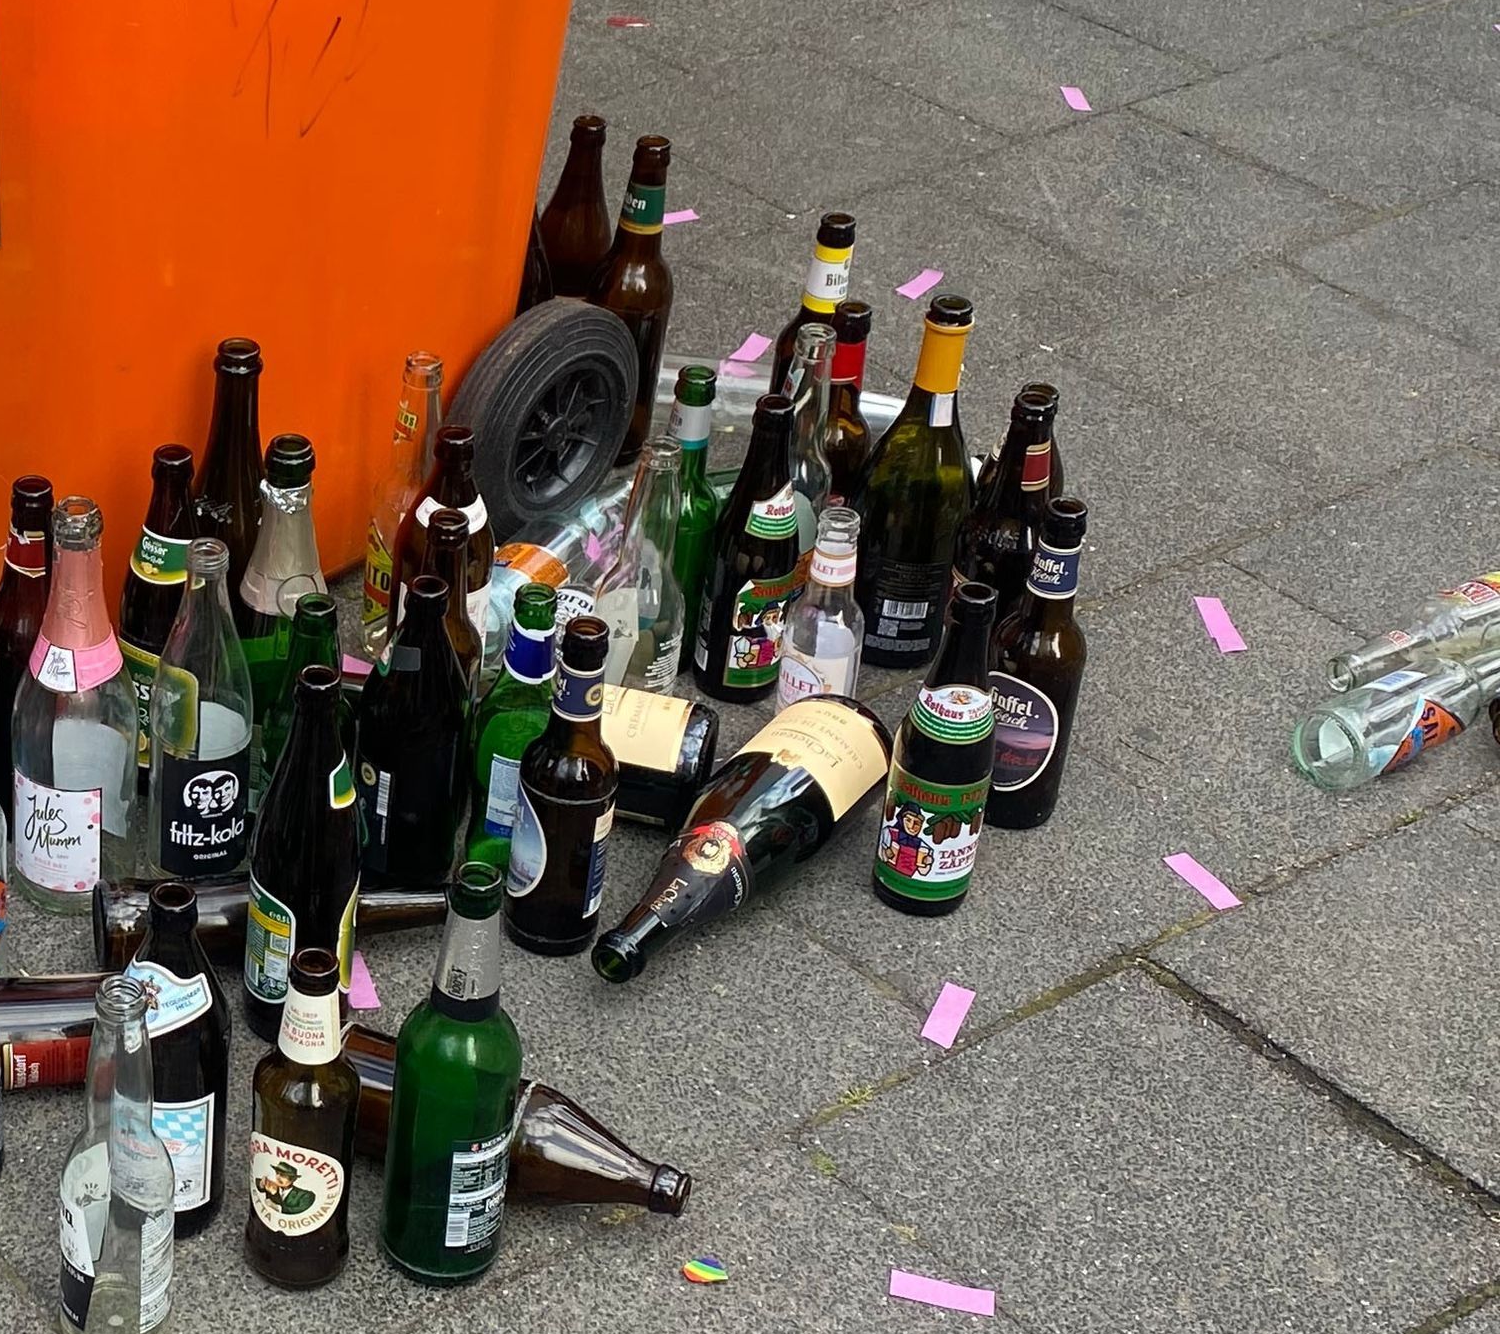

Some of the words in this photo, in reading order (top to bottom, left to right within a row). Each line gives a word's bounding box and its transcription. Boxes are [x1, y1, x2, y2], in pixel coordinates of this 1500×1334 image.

[23, 795, 68, 841] Jules
[169, 817, 245, 847] fritz-kola
[31, 823, 82, 859] Mumm
[291, 1026, 325, 1040] BUONA
[276, 1145, 339, 1191] MORETTI
[277, 1191, 338, 1231] ORIGINALE
